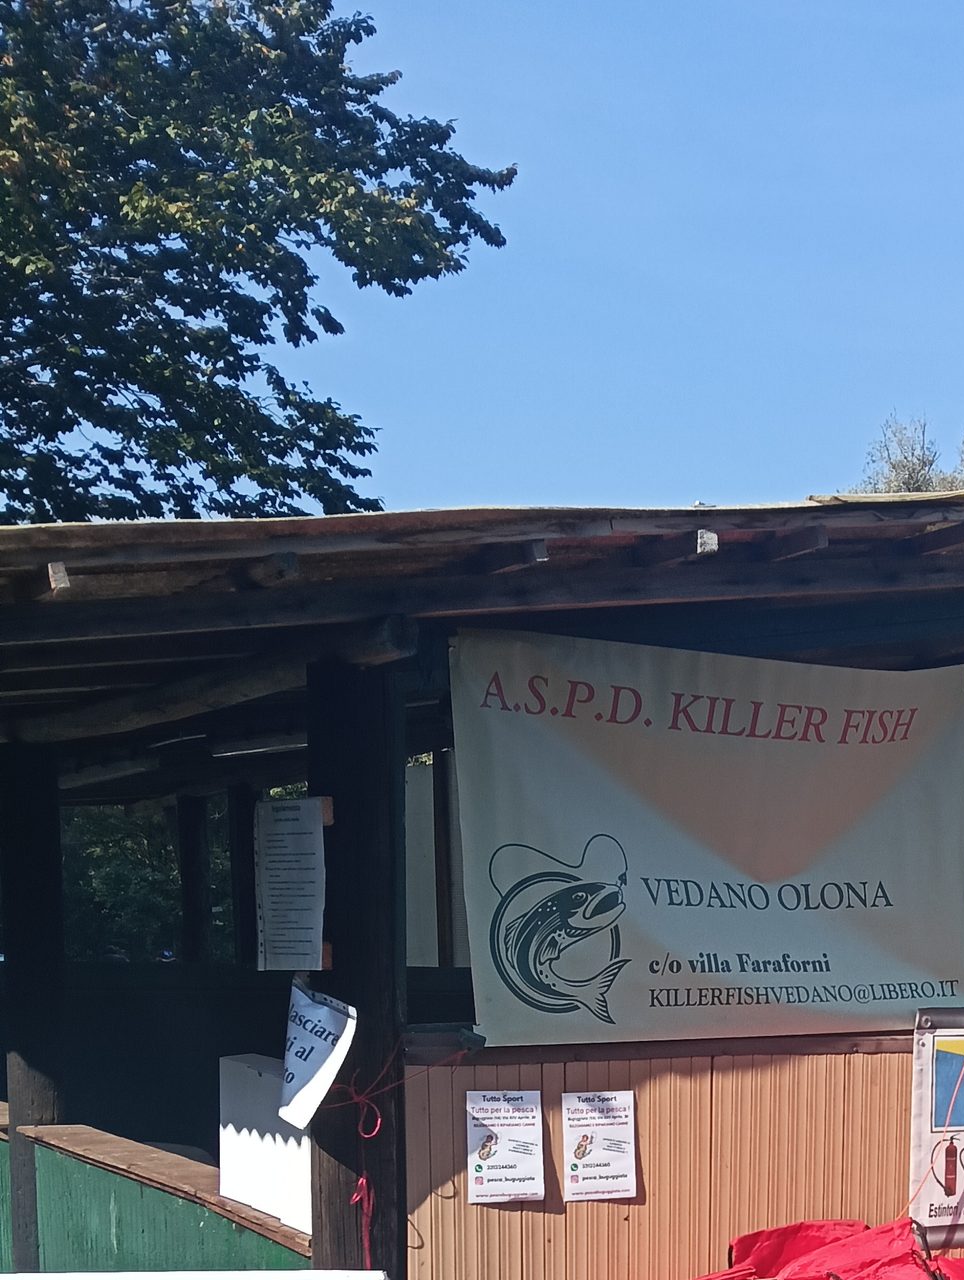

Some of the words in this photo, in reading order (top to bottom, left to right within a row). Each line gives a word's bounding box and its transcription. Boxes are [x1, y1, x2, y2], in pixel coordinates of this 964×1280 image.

[480, 671, 652, 728] A.S.P.D.
[668, 691, 829, 744] KILLER
[838, 707, 918, 745] FISH
[640, 876, 770, 912] VEDANO
[777, 878, 893, 912] OLONA
[648, 954, 682, 976] c/o
[687, 951, 732, 975] villa
[738, 951, 831, 975] Faraforni
[648, 979, 958, 1008] KILLERFISHVEDANO@LIBERO.IT
[294, 1046, 315, 1062] al
[502, 1094, 524, 1104] Sport
[597, 1095, 617, 1104] Sport
[490, 1107, 501, 1115] per
[511, 1107, 534, 1115] pesca
[566, 1107, 584, 1115] Tutto
